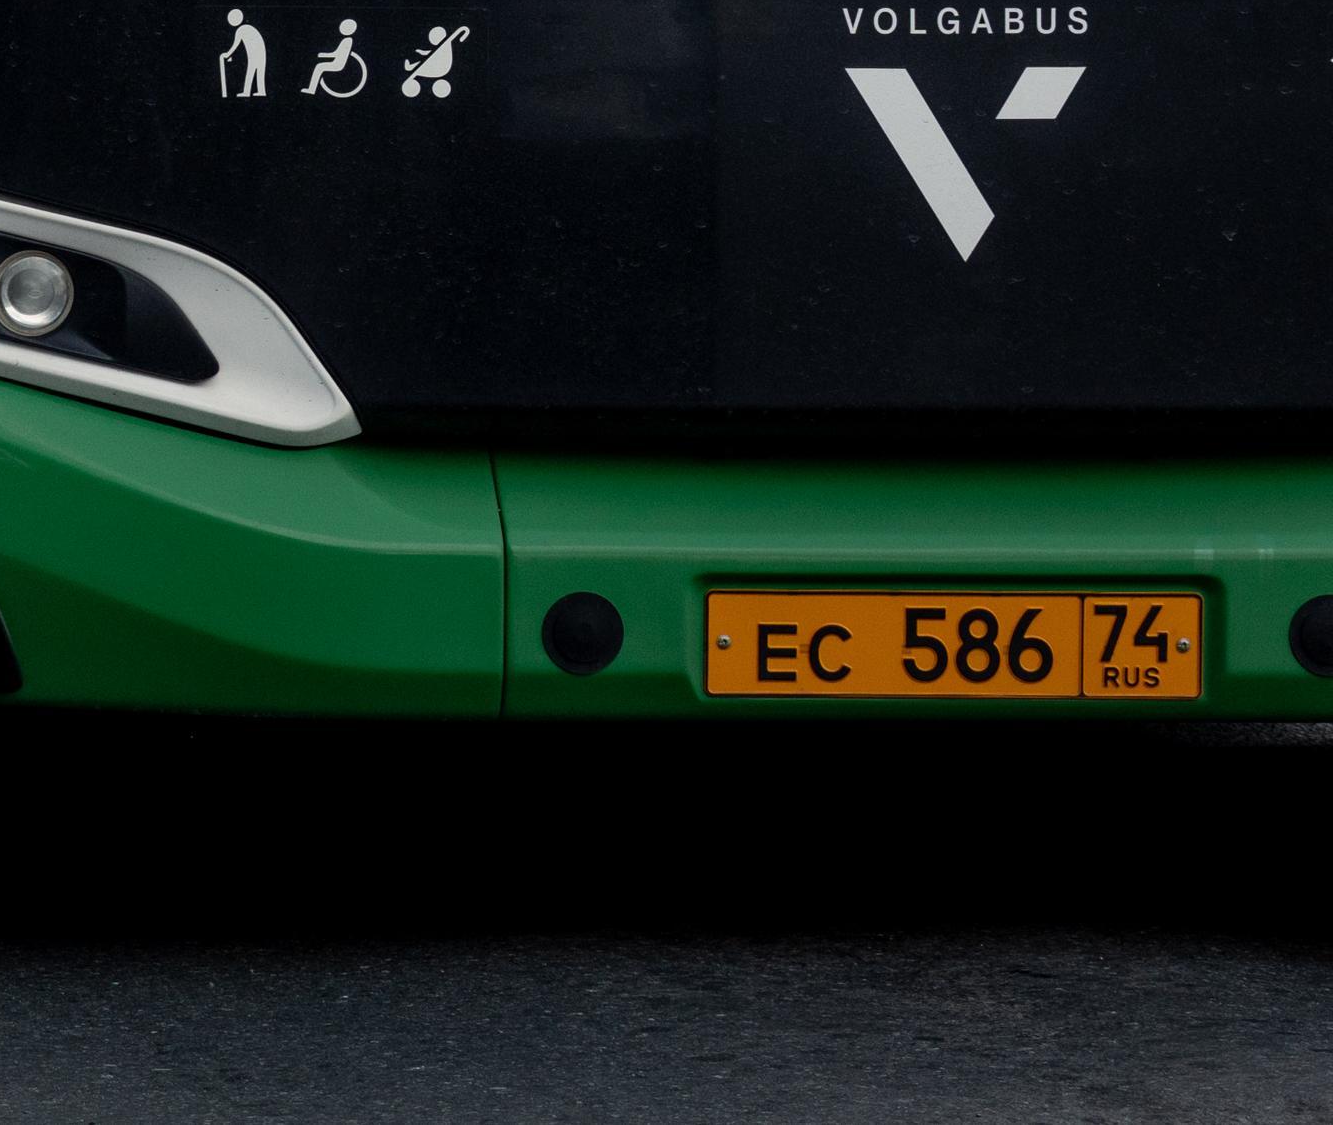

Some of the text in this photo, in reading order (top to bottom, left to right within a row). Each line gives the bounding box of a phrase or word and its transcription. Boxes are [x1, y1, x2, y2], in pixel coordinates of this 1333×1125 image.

[842, 7, 1089, 35] VOLGABUS
[757, 604, 1169, 684] EC 586 74
[1103, 666, 1161, 688] RUS
